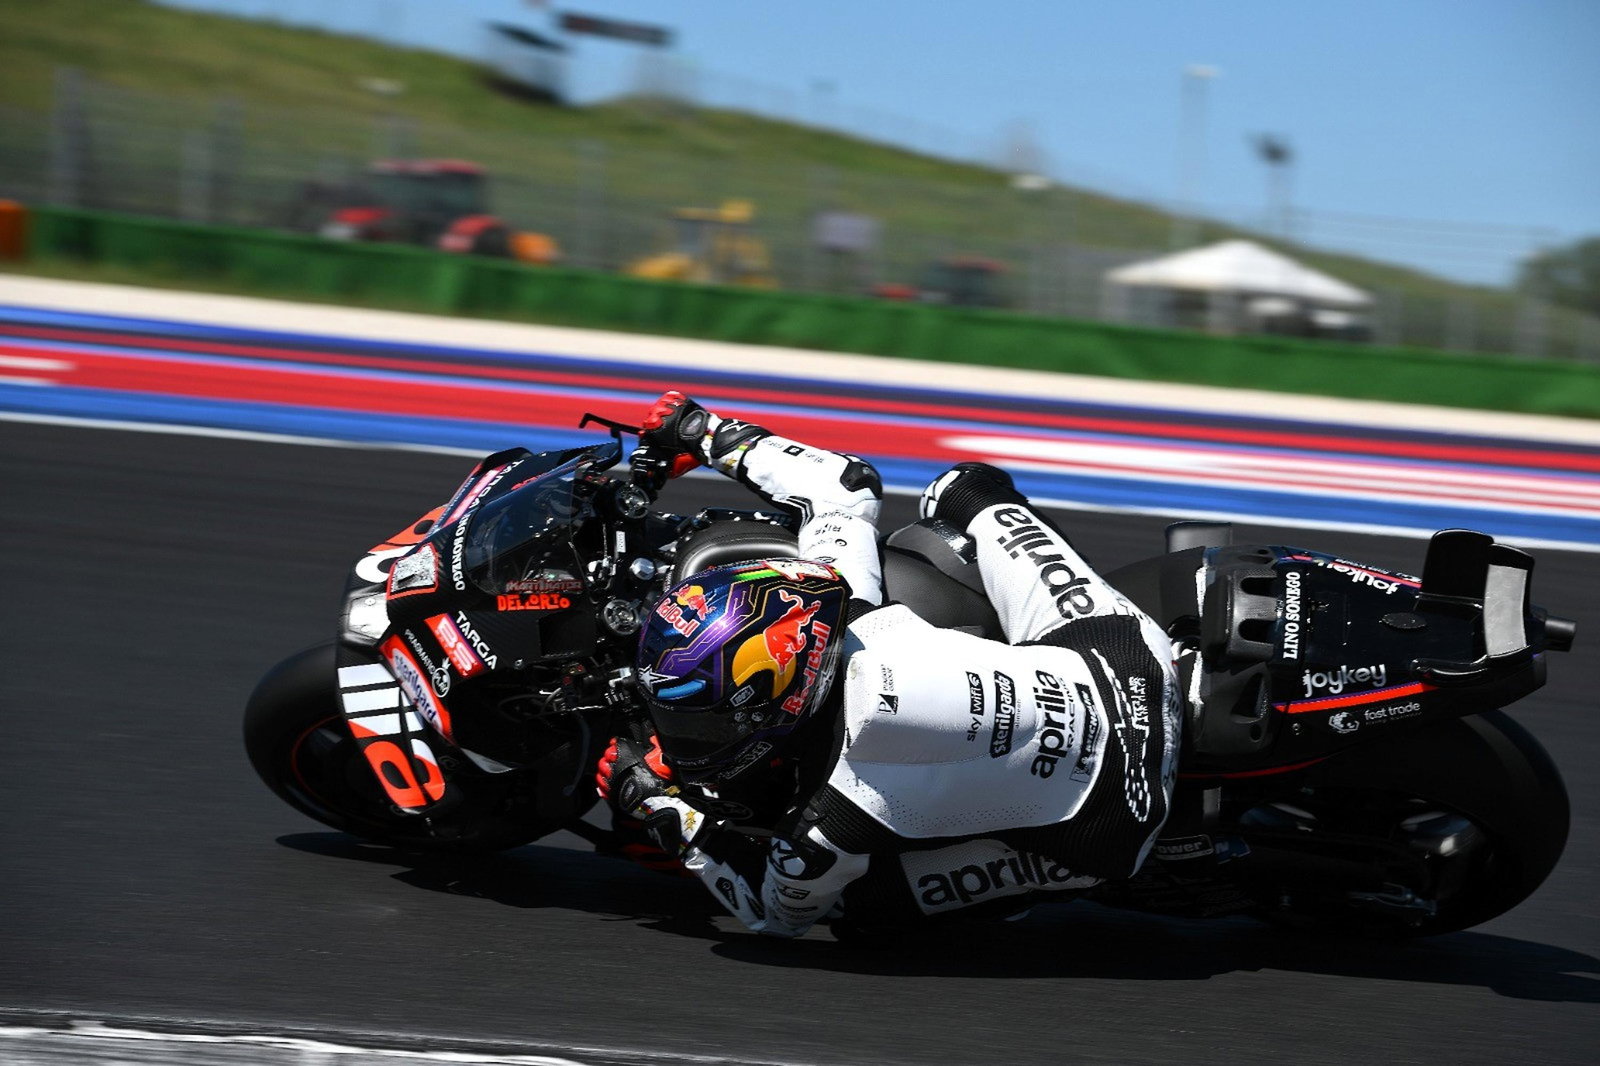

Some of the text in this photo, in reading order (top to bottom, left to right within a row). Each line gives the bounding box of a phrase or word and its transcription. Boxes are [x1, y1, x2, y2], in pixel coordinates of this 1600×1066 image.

[452, 540, 467, 592] SONEGO
[994, 507, 1095, 620] aprilia
[456, 610, 498, 670] TARGA
[664, 605, 701, 638] Bull
[1282, 571, 1302, 660] LINO SONEGO
[403, 628, 437, 675] PRAGMATIC
[437, 617, 476, 672] BS
[780, 620, 831, 716] Red Bull
[1303, 663, 1386, 698] joykey
[966, 686, 983, 742] sky wifi
[993, 675, 1015, 755] sterilgarda
[1030, 670, 1067, 779] aprilia
[1365, 706, 1388, 720] fast
[1389, 701, 1421, 717] trade
[1157, 840, 1203, 855] ower
